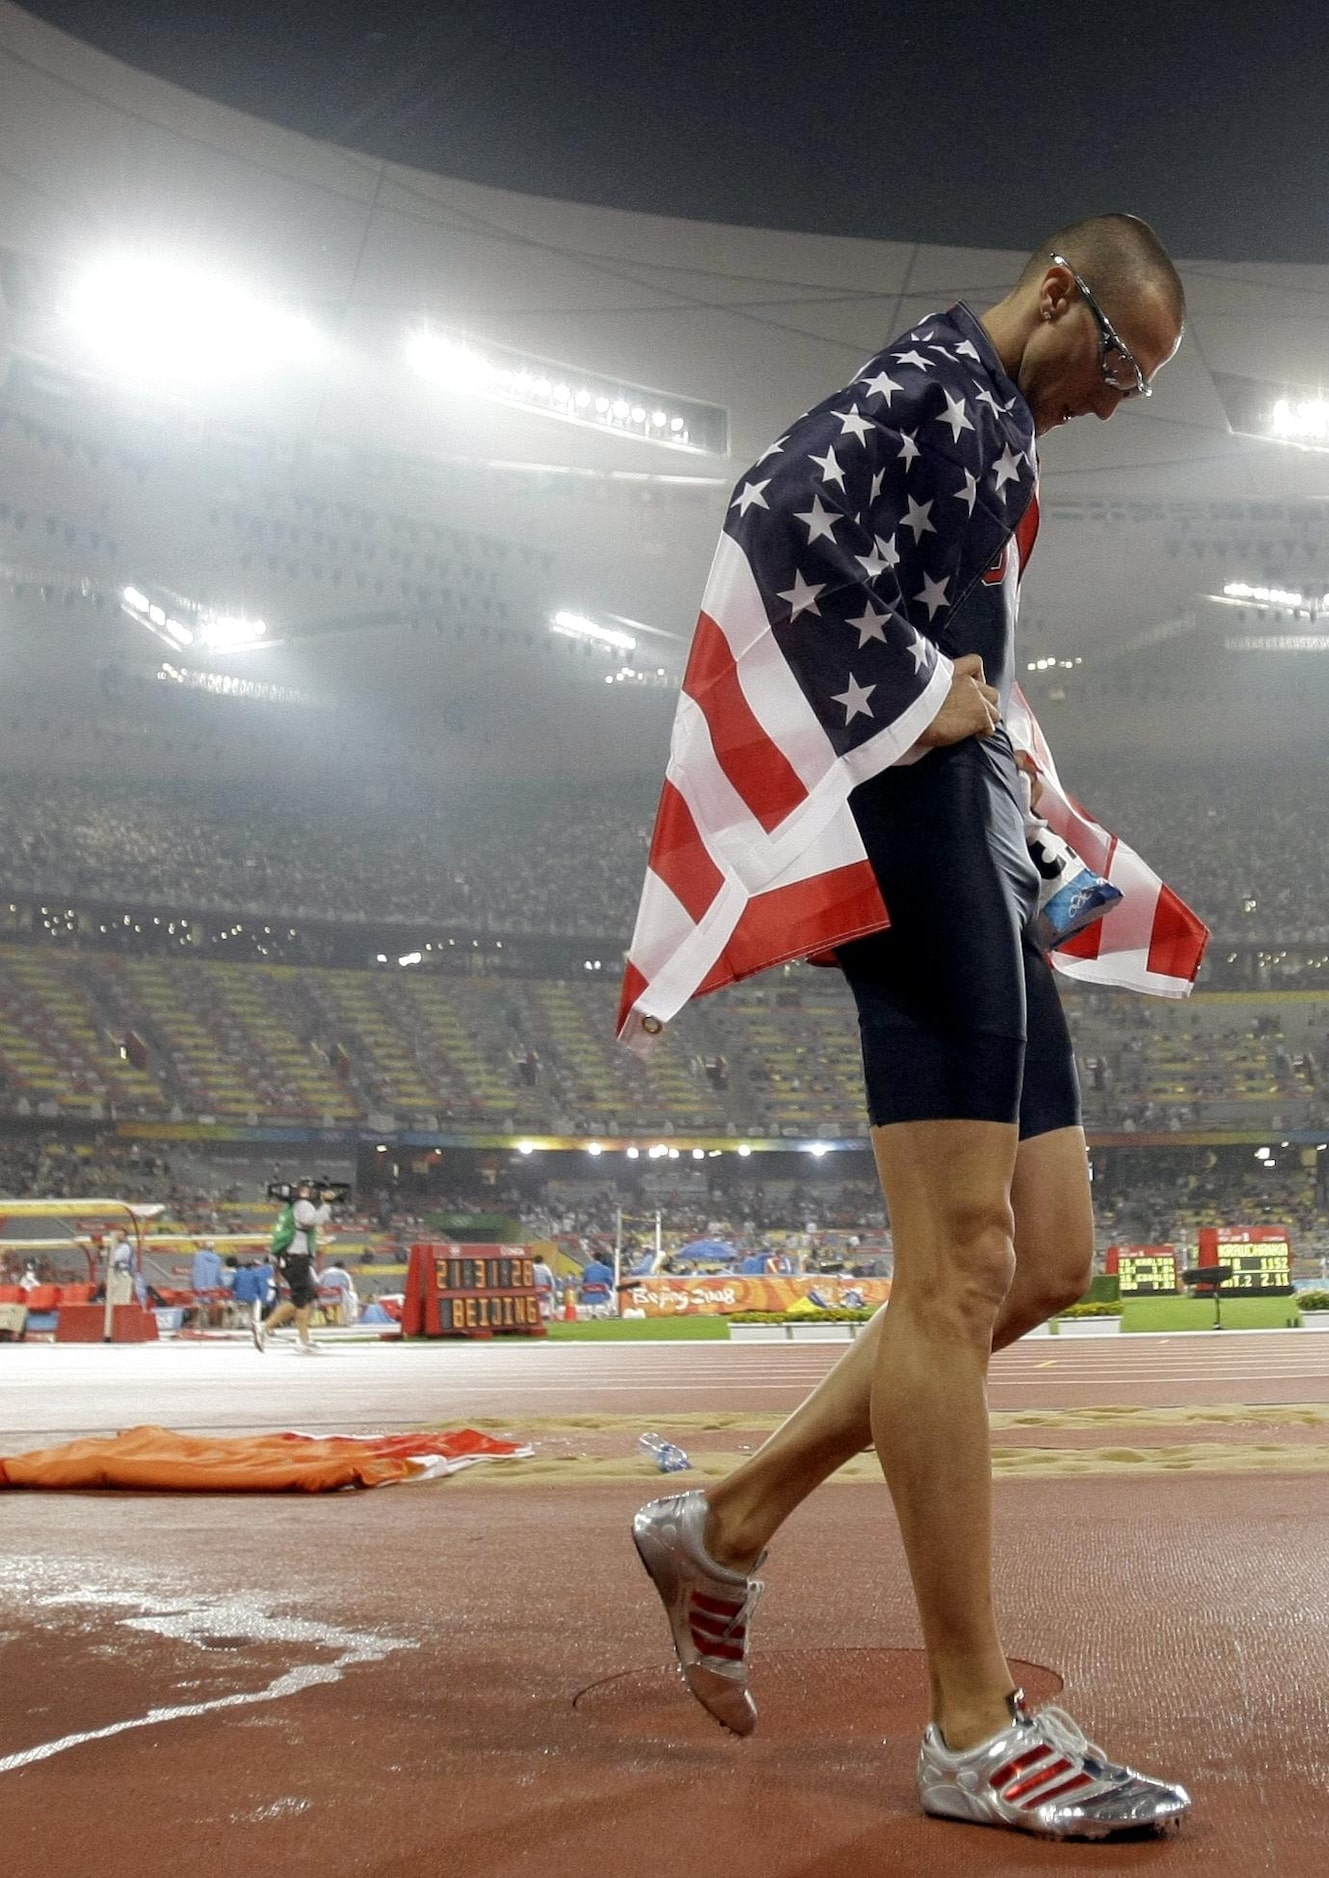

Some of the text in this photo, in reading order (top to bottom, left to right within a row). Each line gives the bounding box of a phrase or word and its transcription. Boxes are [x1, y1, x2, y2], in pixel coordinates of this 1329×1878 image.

[1260, 1256, 1289, 1270] 1152
[1260, 1273, 1290, 1287] 2.11
[628, 1286, 736, 1310] Beijing 2008
[452, 1296, 537, 1328] BEIJING
